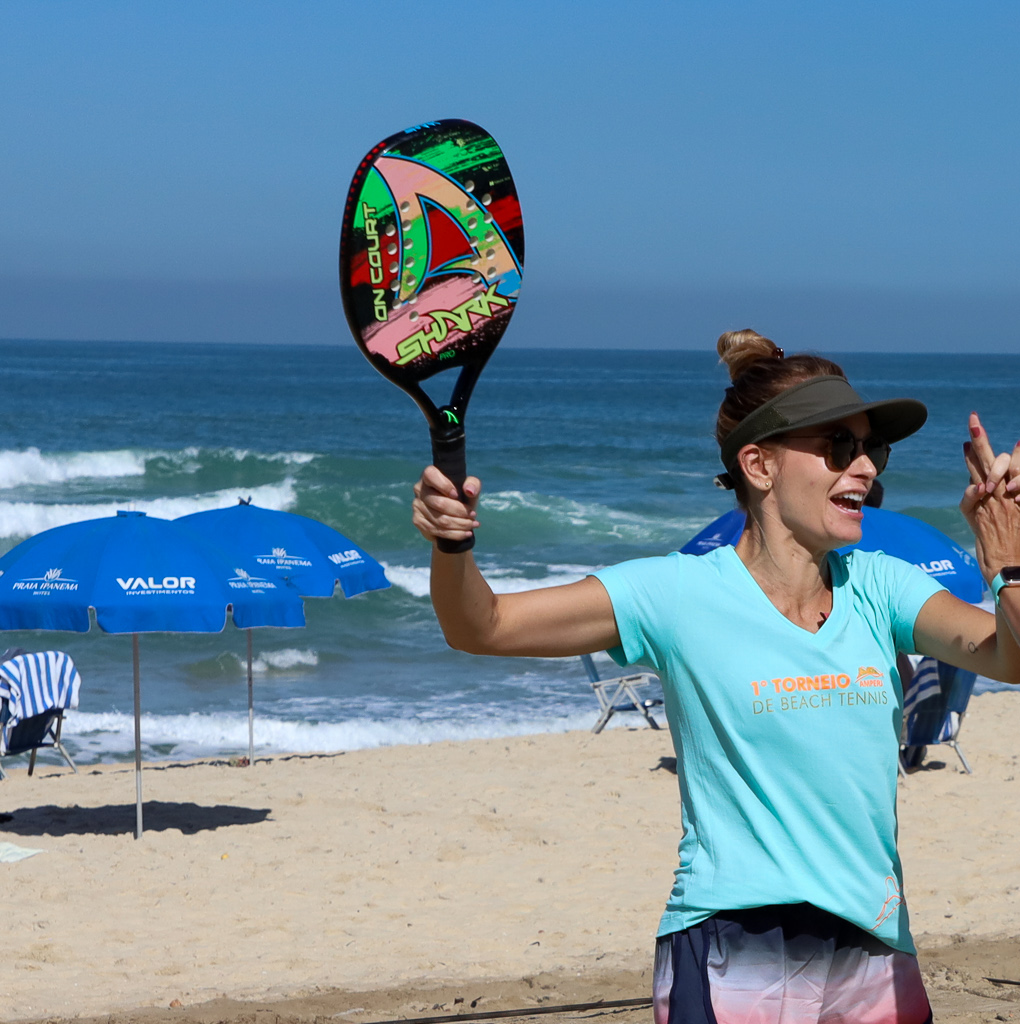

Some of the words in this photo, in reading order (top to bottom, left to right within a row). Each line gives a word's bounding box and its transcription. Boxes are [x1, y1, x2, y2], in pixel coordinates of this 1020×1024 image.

[362, 202, 384, 284] COURT
[373, 289, 388, 321] ON
[395, 283, 509, 365] SHARK
[328, 549, 363, 564] VALOR
[12, 582, 38, 591] PRAIA
[39, 582, 79, 591] IPANEMA
[116, 576, 196, 590] VALOR
[771, 672, 851, 693] TORNEIO
[752, 698, 775, 715] DE
[780, 693, 832, 711] BEACH
[838, 690, 888, 706] TENNIS
